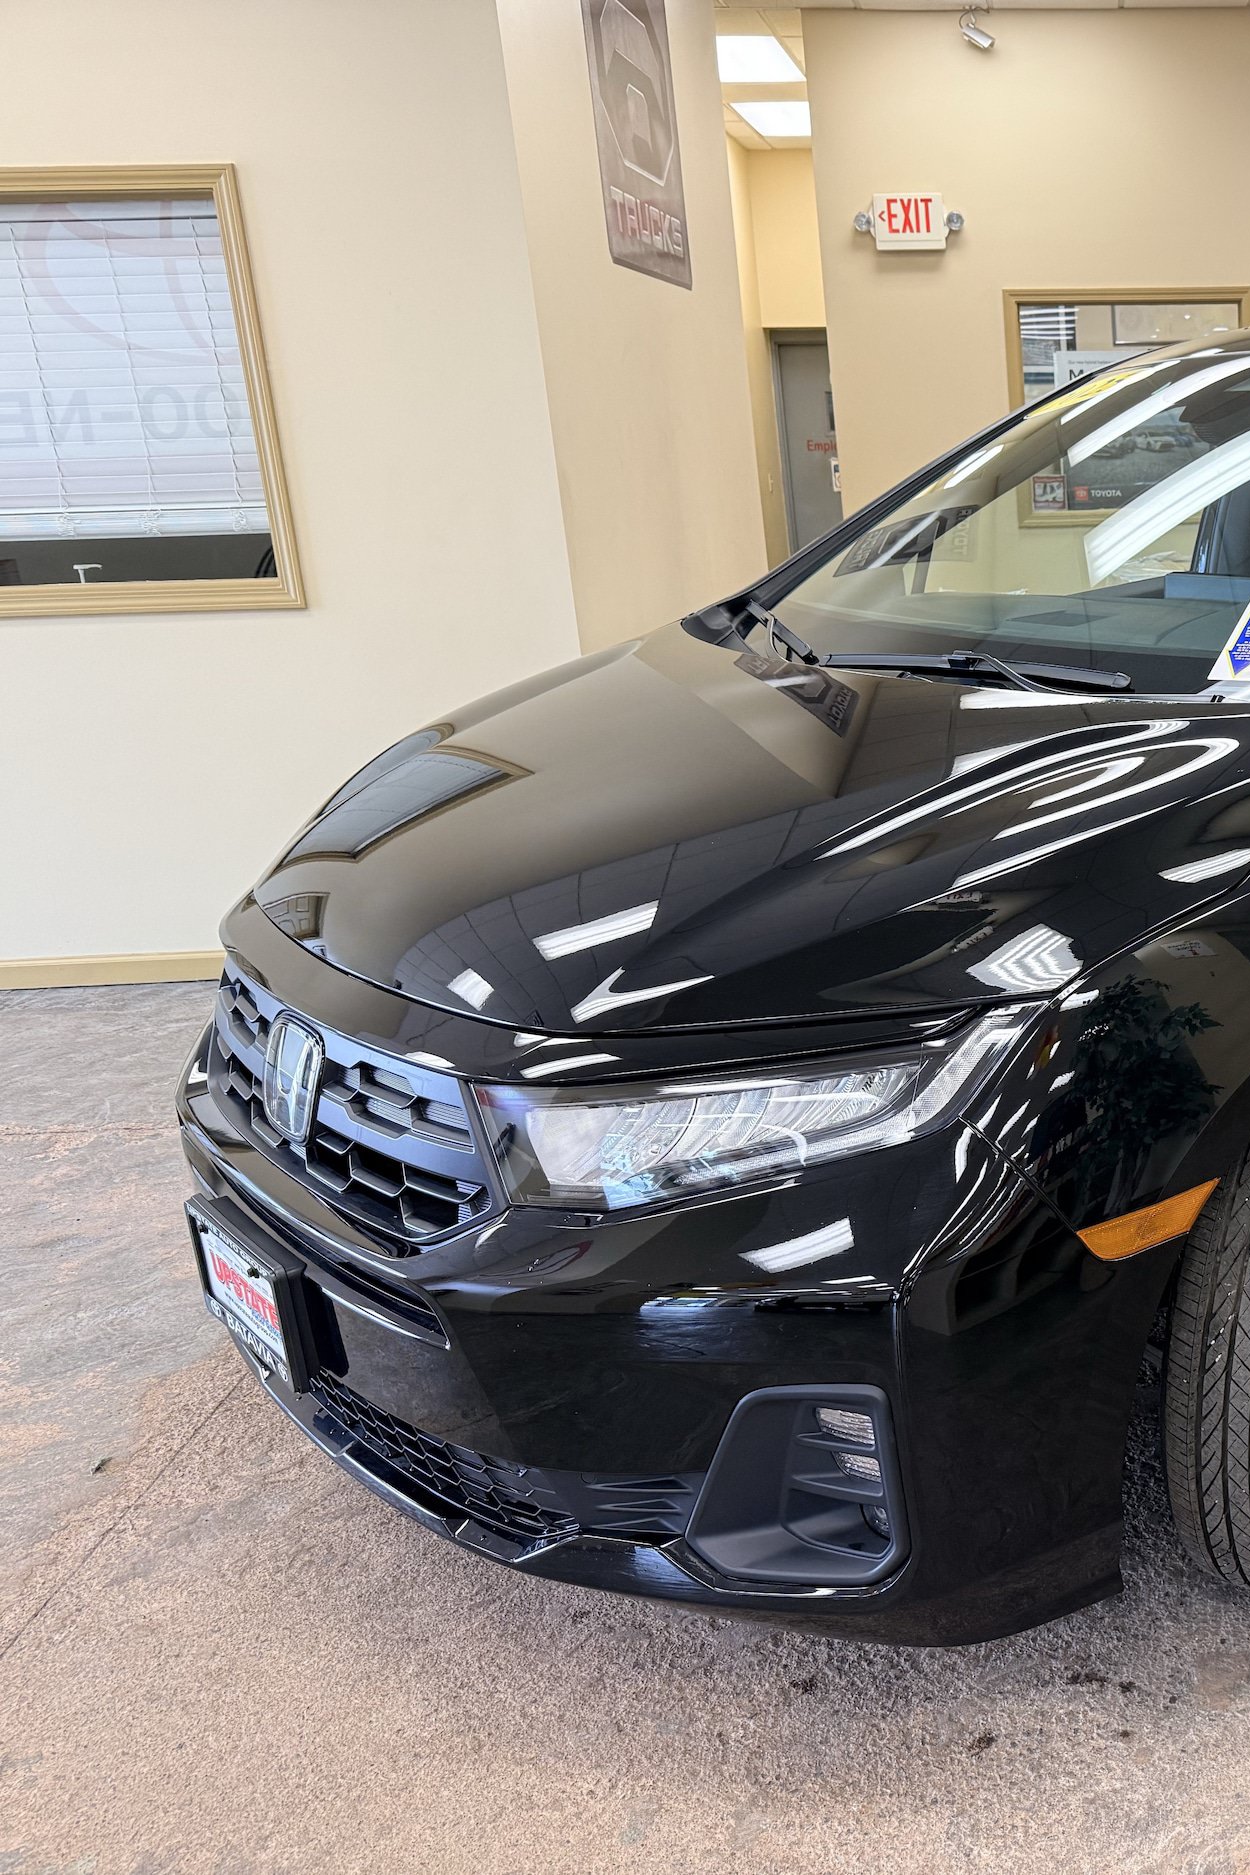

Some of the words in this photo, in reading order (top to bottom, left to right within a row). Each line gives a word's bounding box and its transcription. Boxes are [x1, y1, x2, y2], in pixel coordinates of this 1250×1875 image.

[610, 185, 684, 258] TRUCKS
[886, 198, 933, 233] EXIT
[1090, 489, 1122, 498] TOYOTA
[209, 1249, 281, 1331] UPSTATE
[226, 1313, 277, 1370] BATAVIA
